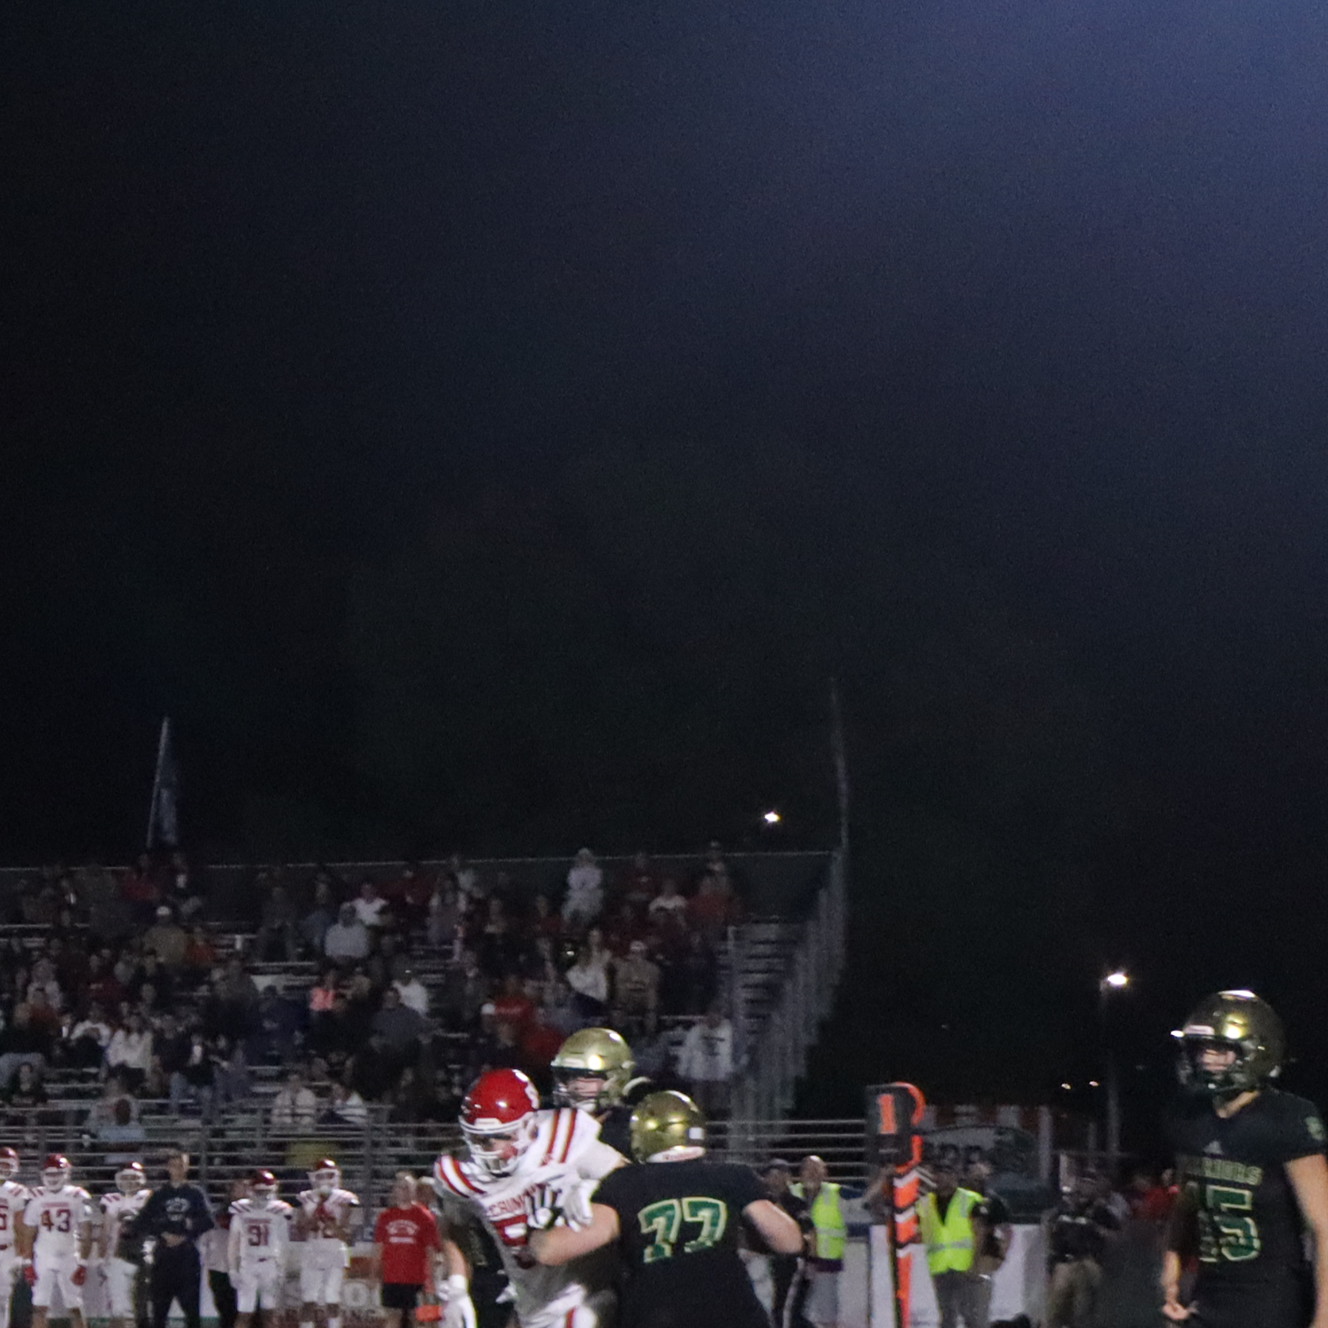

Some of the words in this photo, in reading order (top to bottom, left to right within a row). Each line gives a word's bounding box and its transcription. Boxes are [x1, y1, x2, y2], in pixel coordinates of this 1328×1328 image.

[877, 1093, 898, 1135] 1
[40, 1209, 72, 1233] 43
[637, 1196, 728, 1262] 77
